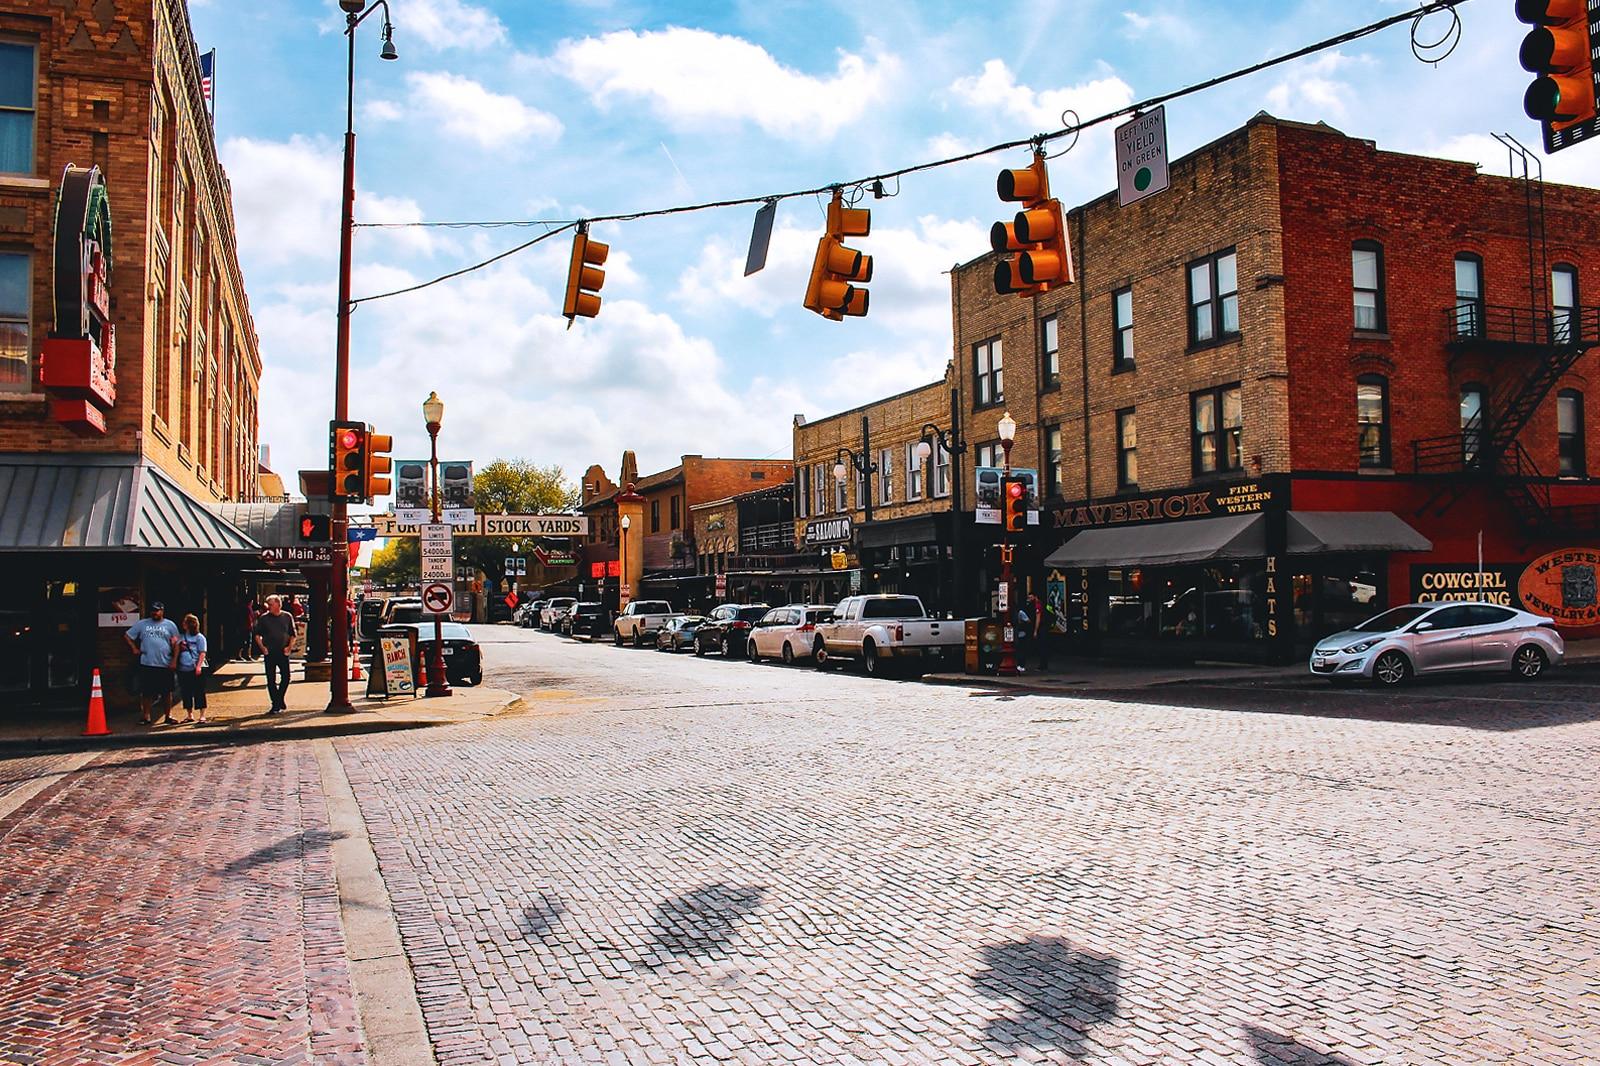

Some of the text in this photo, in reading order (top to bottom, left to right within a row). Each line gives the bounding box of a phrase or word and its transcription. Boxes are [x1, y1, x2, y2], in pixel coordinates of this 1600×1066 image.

[1120, 114, 1160, 142] LEFT TURN
[1126, 132, 1155, 154] YIELD
[1121, 146, 1162, 172] ON GREEN
[1215, 491, 1272, 506] WESTERN
[1228, 484, 1258, 496] FINE
[1051, 491, 1212, 529] MAVERICK
[1227, 502, 1261, 513] WEAR
[487, 520, 532, 534] STOCK
[537, 519, 581, 534] YARDS
[815, 520, 842, 541] SALOON
[275, 548, 314, 560] N Main
[1535, 552, 1600, 574] WESTE
[1422, 572, 1506, 589] COWGIRL
[1081, 568, 1089, 631] BOOTS
[1266, 556, 1277, 637] HATS
[1418, 592, 1511, 606] CLOTHING
[1525, 591, 1585, 619] JEWELRY
[1587, 608, 1595, 619] &
[386, 648, 407, 664] RANCH
